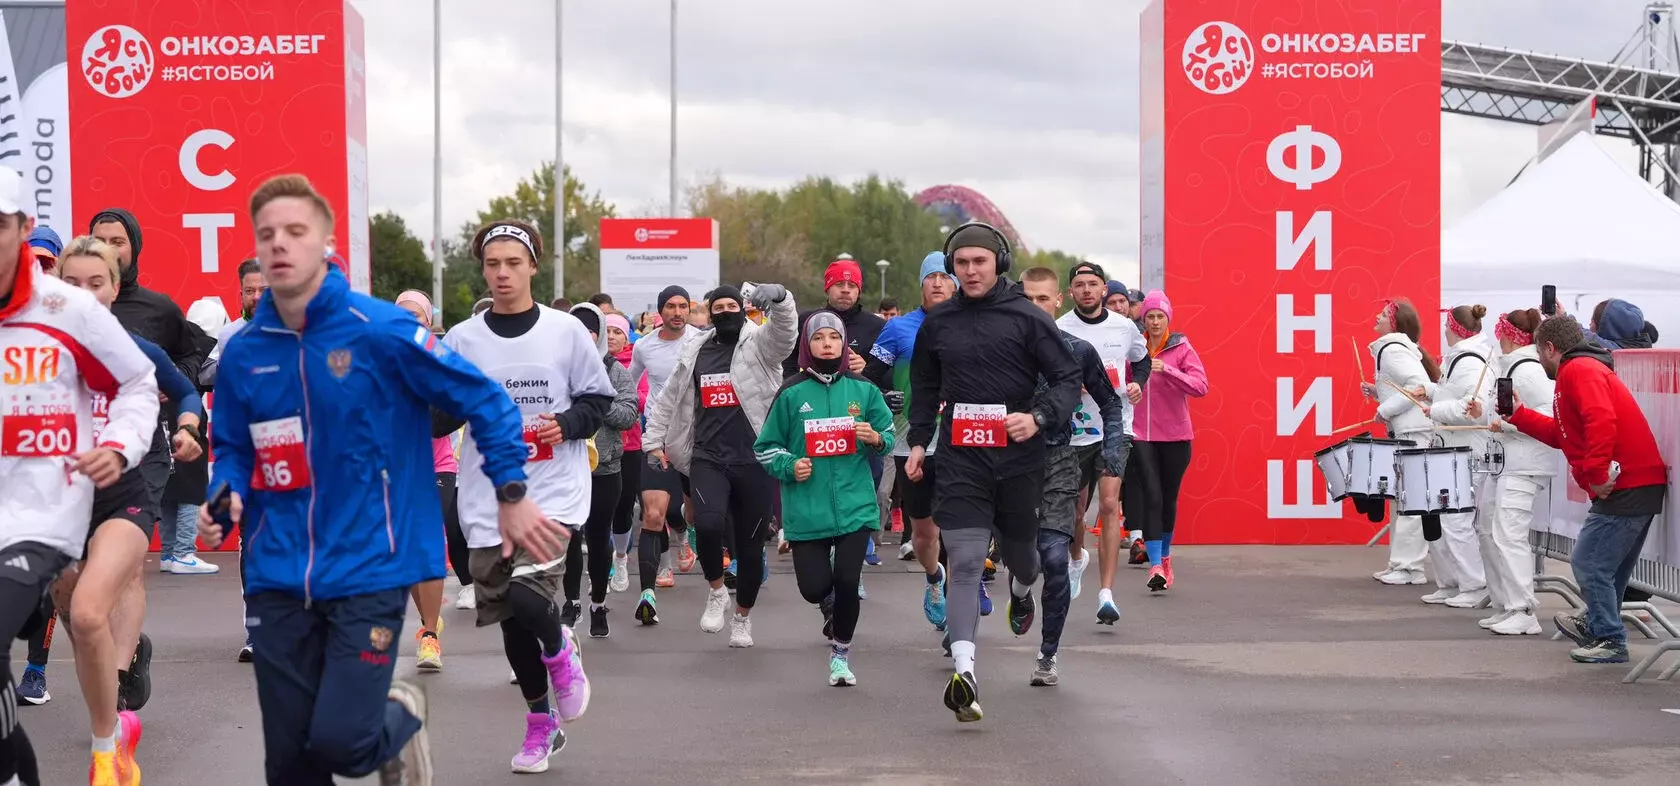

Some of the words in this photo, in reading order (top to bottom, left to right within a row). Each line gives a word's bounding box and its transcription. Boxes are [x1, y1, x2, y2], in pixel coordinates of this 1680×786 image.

[160, 35, 325, 56] ОНКОЗАБЕГ
[1261, 33, 1426, 53] ОНКОЗАБЕГ
[161, 61, 274, 81] #ЯСТОБОЙ
[1261, 59, 1374, 78] #ЯСТОБОЙ
[32, 118, 54, 227] moda
[1266, 125, 1342, 519] ФИНИШ
[505, 379, 549, 389] бежим
[710, 392, 735, 405] 291
[973, 411, 1003, 420] ТОБОЙ
[17, 427, 71, 454] 200
[962, 428, 995, 444] 281
[815, 438, 847, 454] 209
